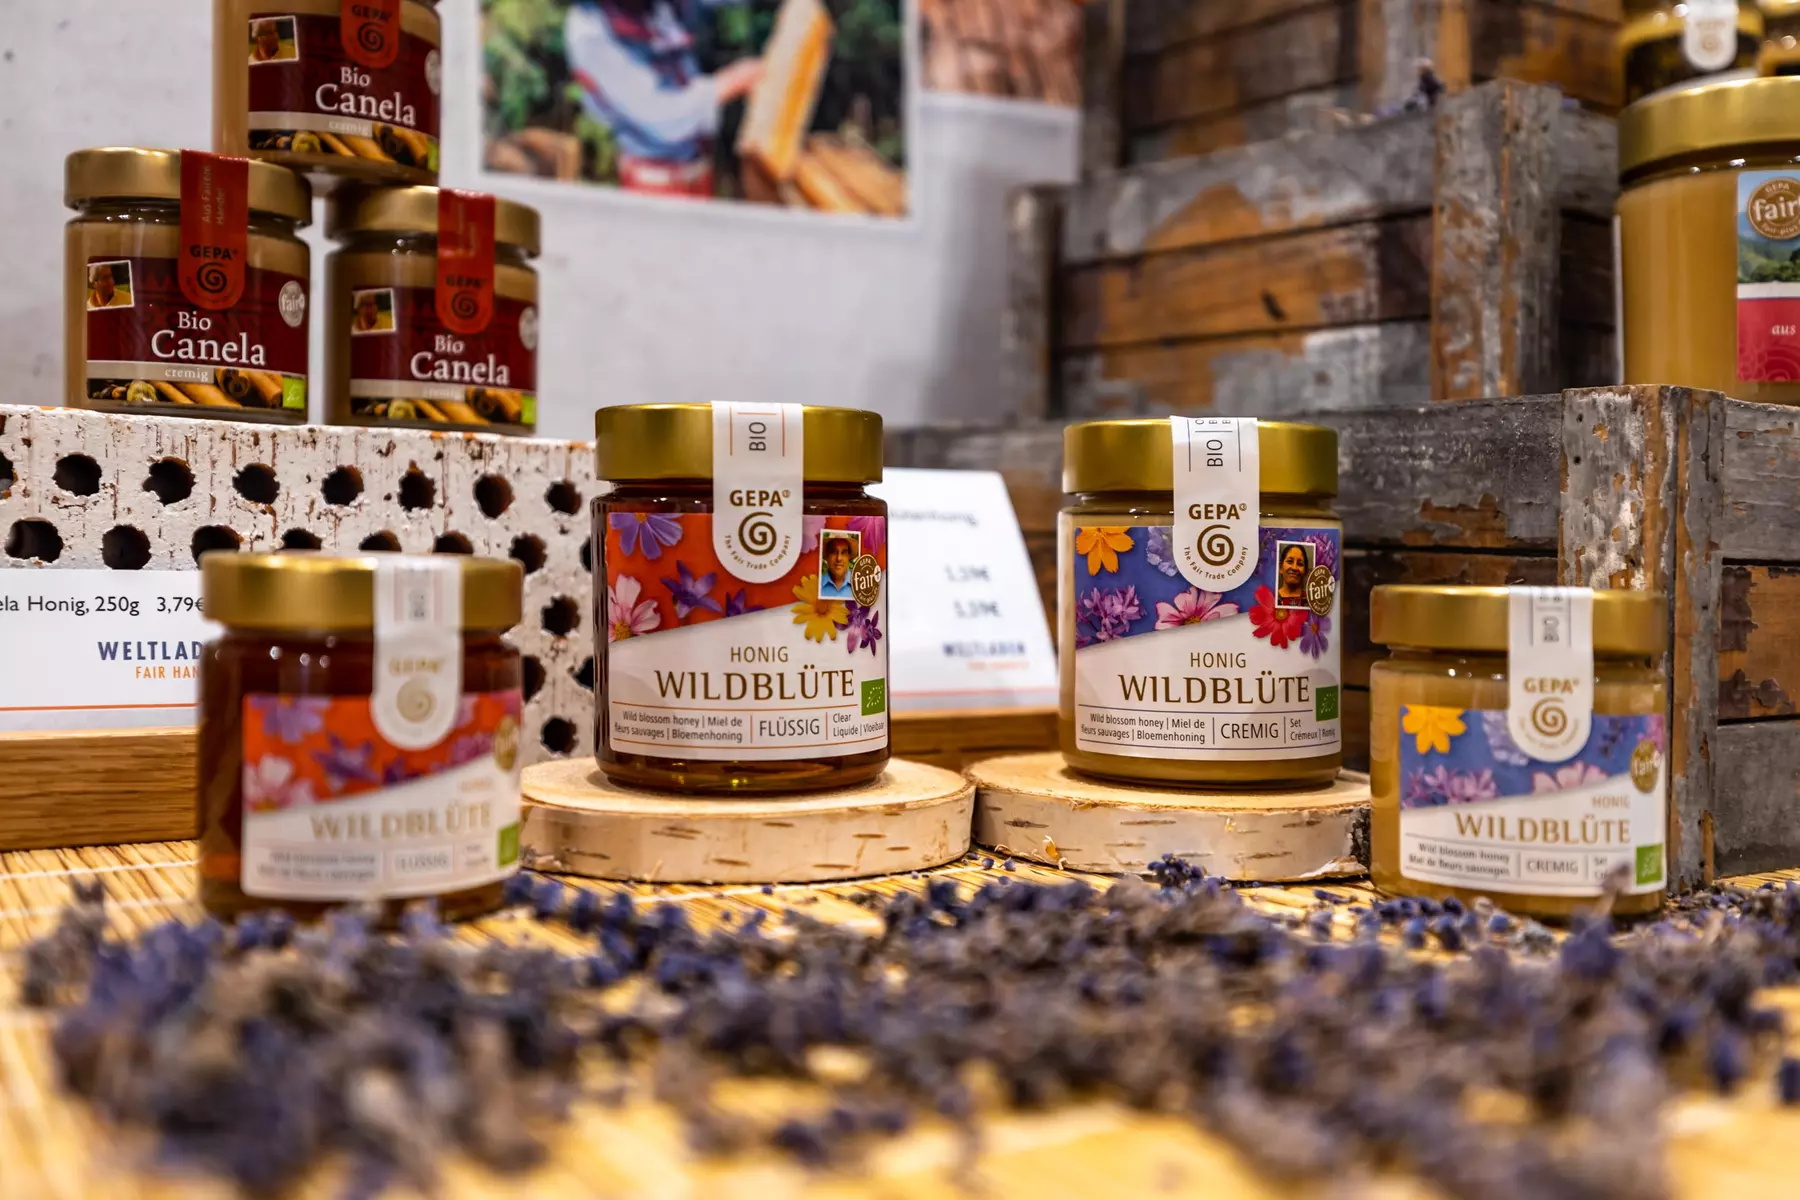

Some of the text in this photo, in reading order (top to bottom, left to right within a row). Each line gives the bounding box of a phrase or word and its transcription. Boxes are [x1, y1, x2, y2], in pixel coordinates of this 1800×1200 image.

[340, 66, 371, 87] Bio
[315, 83, 416, 126] Canela
[1754, 196, 1800, 222] fair
[177, 311, 211, 331] Bio
[1771, 324, 1797, 336] aus
[151, 330, 266, 366] Canela
[434, 334, 465, 354] Bio
[164, 368, 209, 382] cremig
[410, 352, 510, 386] Canela
[748, 421, 767, 452] BIO
[1206, 439, 1224, 467] BIO
[725, 534, 792, 570] The Fair Trade Company
[1183, 546, 1249, 580] The Fair Trade Company
[27, 596, 90, 617] Honig,
[94, 596, 140, 617] 250g
[157, 596, 205, 614] 3,79€
[730, 646, 789, 663] HONIG
[1190, 652, 1247, 668] HONIG
[135, 666, 166, 679] FAIR
[654, 664, 855, 701] WILDBLÜTE
[1118, 670, 1310, 705] WILDBLÜTE
[623, 710, 743, 728] Wild blossom honey Miel de
[759, 716, 820, 737] FLÜSSIG
[833, 713, 852, 724] Clear
[1089, 713, 1205, 730] Wild blossom honey Miel de
[1290, 718, 1301, 728] Set
[631, 727, 664, 740] sauvages
[672, 728, 743, 744] Bloemenhoning
[833, 725, 859, 738] Liquide
[1097, 728, 1130, 740] sauvages
[1137, 730, 1206, 744] Bloemenhoning
[1220, 722, 1279, 739] CREMIG
[1290, 730, 1318, 741] Crémeux
[1453, 812, 1631, 845] WILDBLÜTE
